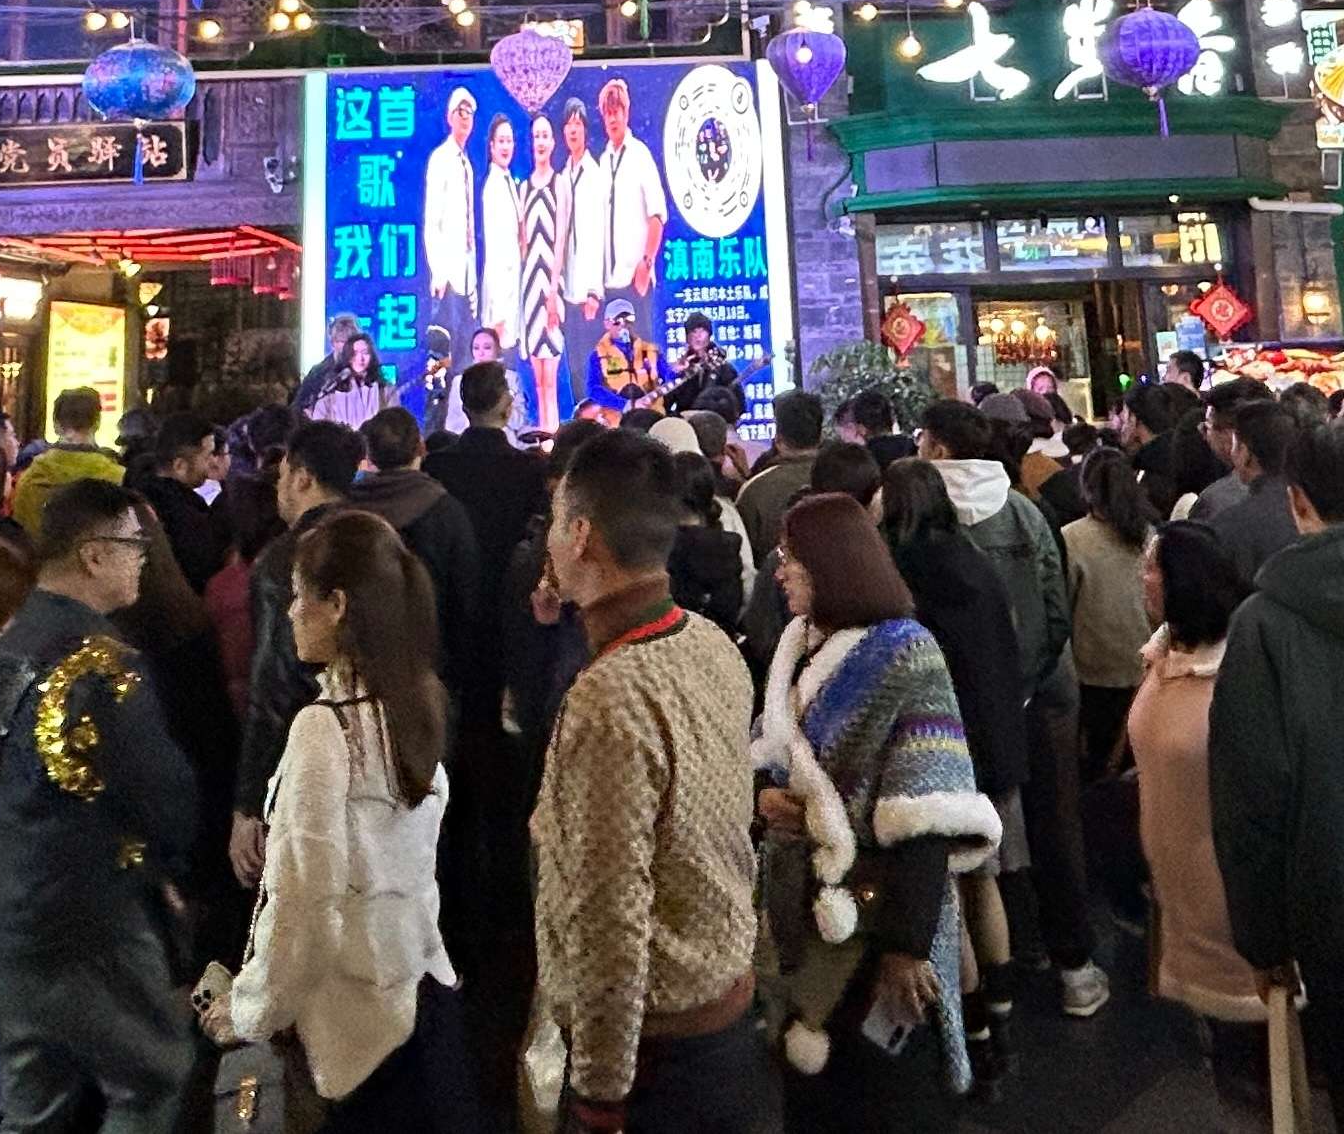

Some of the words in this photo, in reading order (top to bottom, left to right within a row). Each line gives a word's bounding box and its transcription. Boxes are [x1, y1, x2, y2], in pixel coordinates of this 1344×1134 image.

[335, 85, 415, 140] 这首
[358, 154, 396, 207] 歌
[334, 224, 416, 279] 我们
